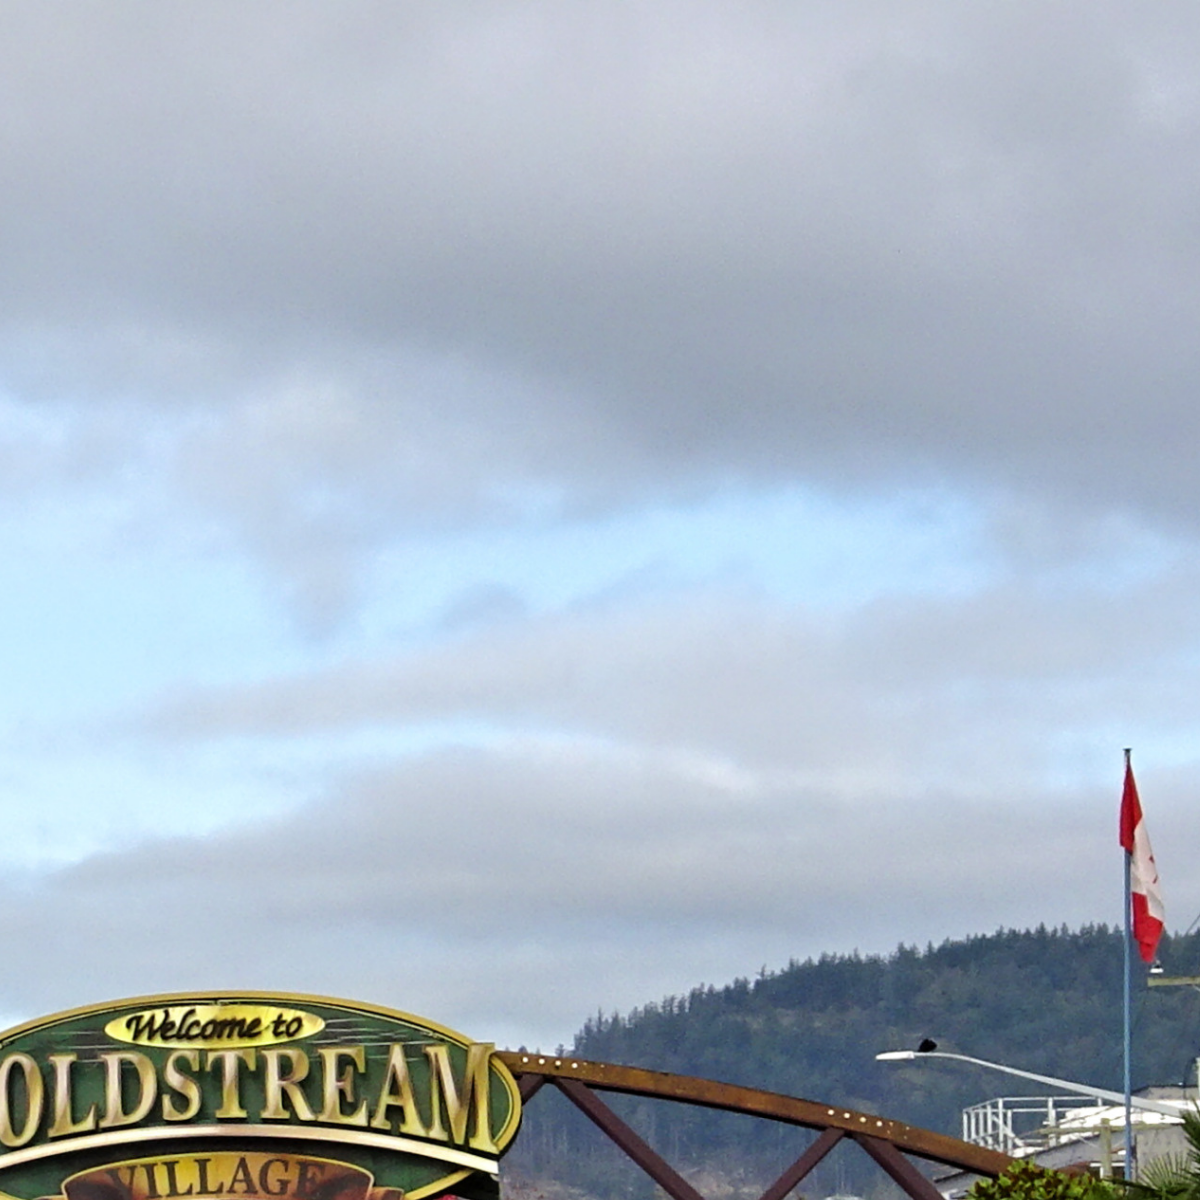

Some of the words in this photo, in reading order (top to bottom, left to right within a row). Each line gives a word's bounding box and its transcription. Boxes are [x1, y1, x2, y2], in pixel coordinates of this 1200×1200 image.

[126, 1008, 262, 1041] Welcome
[272, 1013, 303, 1037] to
[105, 1156, 327, 1200] VILLAGE
